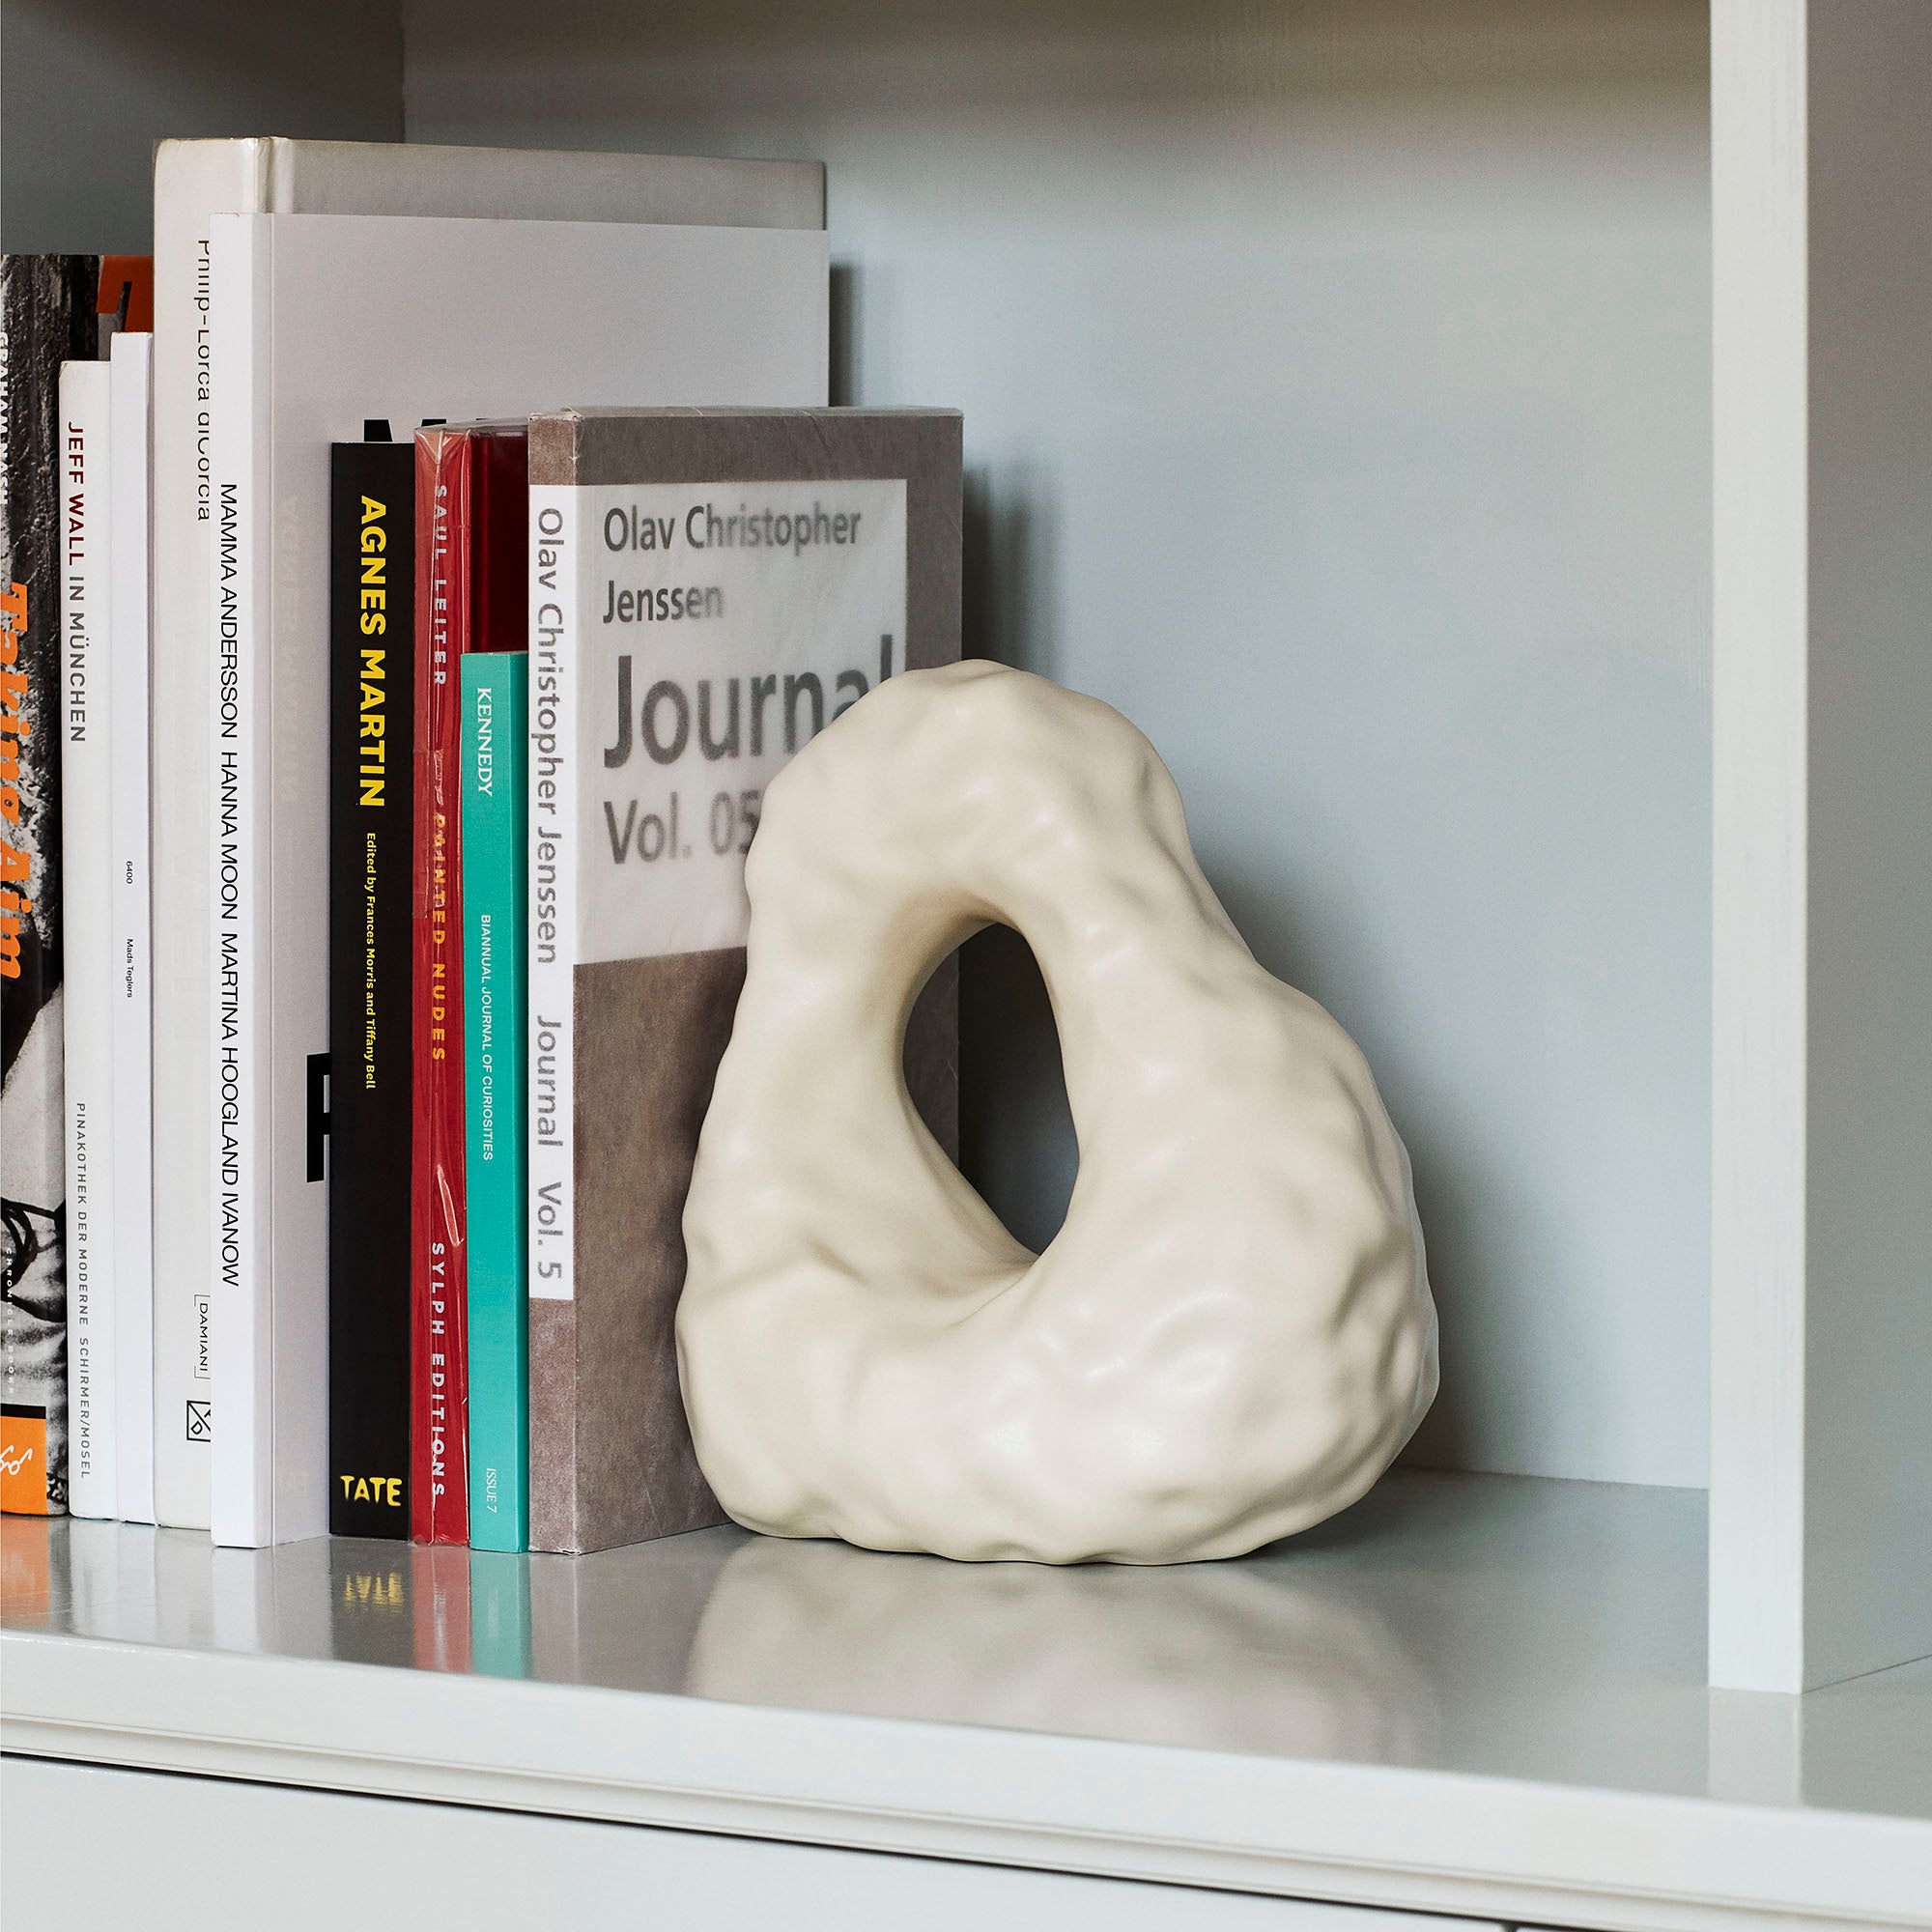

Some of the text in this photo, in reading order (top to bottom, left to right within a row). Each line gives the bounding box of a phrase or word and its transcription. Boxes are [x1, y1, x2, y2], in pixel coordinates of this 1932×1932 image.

[68, 421, 90, 742] JEFF WALL IN MÜNCHEN
[359, 495, 387, 807] AGNES MARTIN
[434, 484, 448, 686] SAUL LEITER
[603, 500, 862, 557] Olav Christopher
[603, 580, 724, 624] Jenssen
[477, 687, 493, 797] KENNEDY
[531, 507, 565, 964] Olav Christopher Jenssen
[603, 791, 693, 865] Vol.
[125, 938, 134, 998] Mads Teglers
[220, 484, 240, 1287] MAMMA ANDERSSON HANNA MOON MARTINA HOOGLAND IVANOW
[363, 832, 377, 1089] Edited by Frances Morris and Tiffany Bell
[432, 814, 446, 1061] PAINTED NUDES
[480, 914, 494, 1161] BIANNUAL JOURNAL OF CURIOSITIES
[537, 1014, 564, 1279] Journal Vol. 5
[76, 1102, 91, 1479] PINAKOTHEK DER MODERNE SCHIRMER/MOSEL
[199, 1302, 209, 1372] DAMIANI
[431, 1241, 445, 1497] SYLPH EDITIONS
[340, 1475, 403, 1507] TATE
[486, 1467, 497, 1515] ISSUE 7
